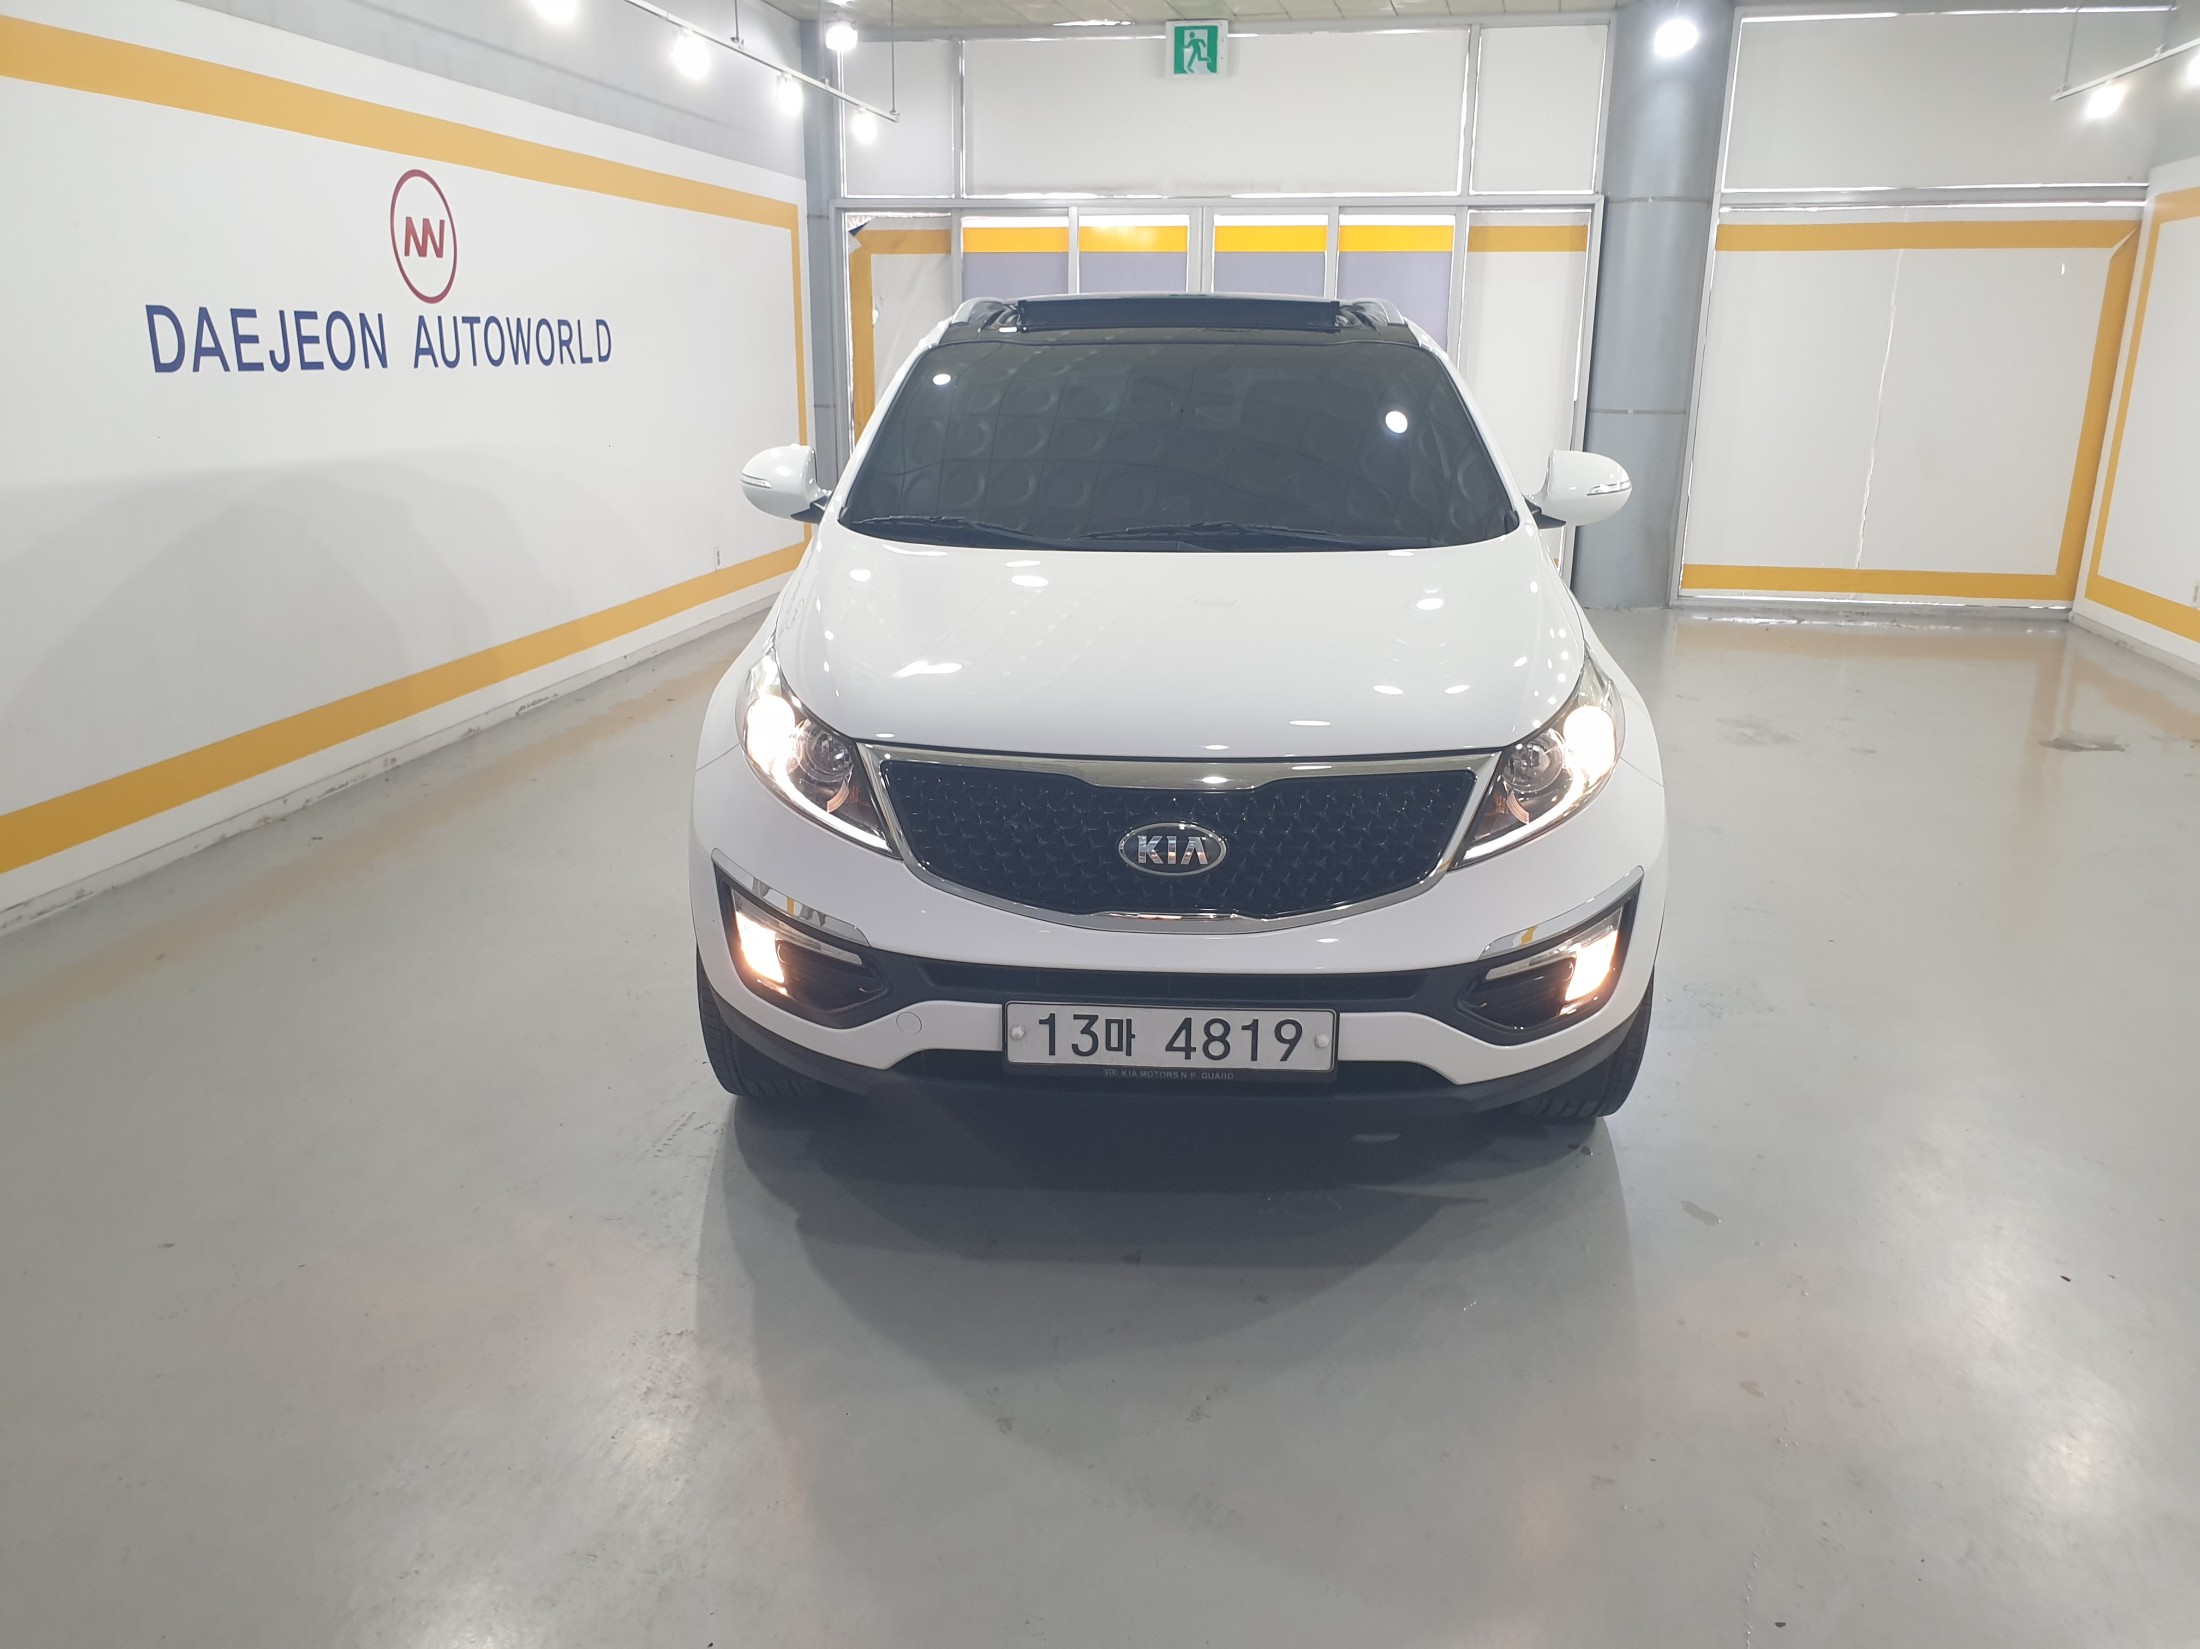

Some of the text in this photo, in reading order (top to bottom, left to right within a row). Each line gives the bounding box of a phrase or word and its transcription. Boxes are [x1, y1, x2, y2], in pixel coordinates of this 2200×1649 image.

[145, 303, 613, 373] DAEJEON AUTOWORLD
[1137, 835, 1209, 865] KIA
[1038, 1012, 1304, 1062] 13마 4819
[1121, 1069, 1138, 1077] KIA
[1139, 1070, 1179, 1079] MOTORS
[1201, 1072, 1234, 1080] GUARD
